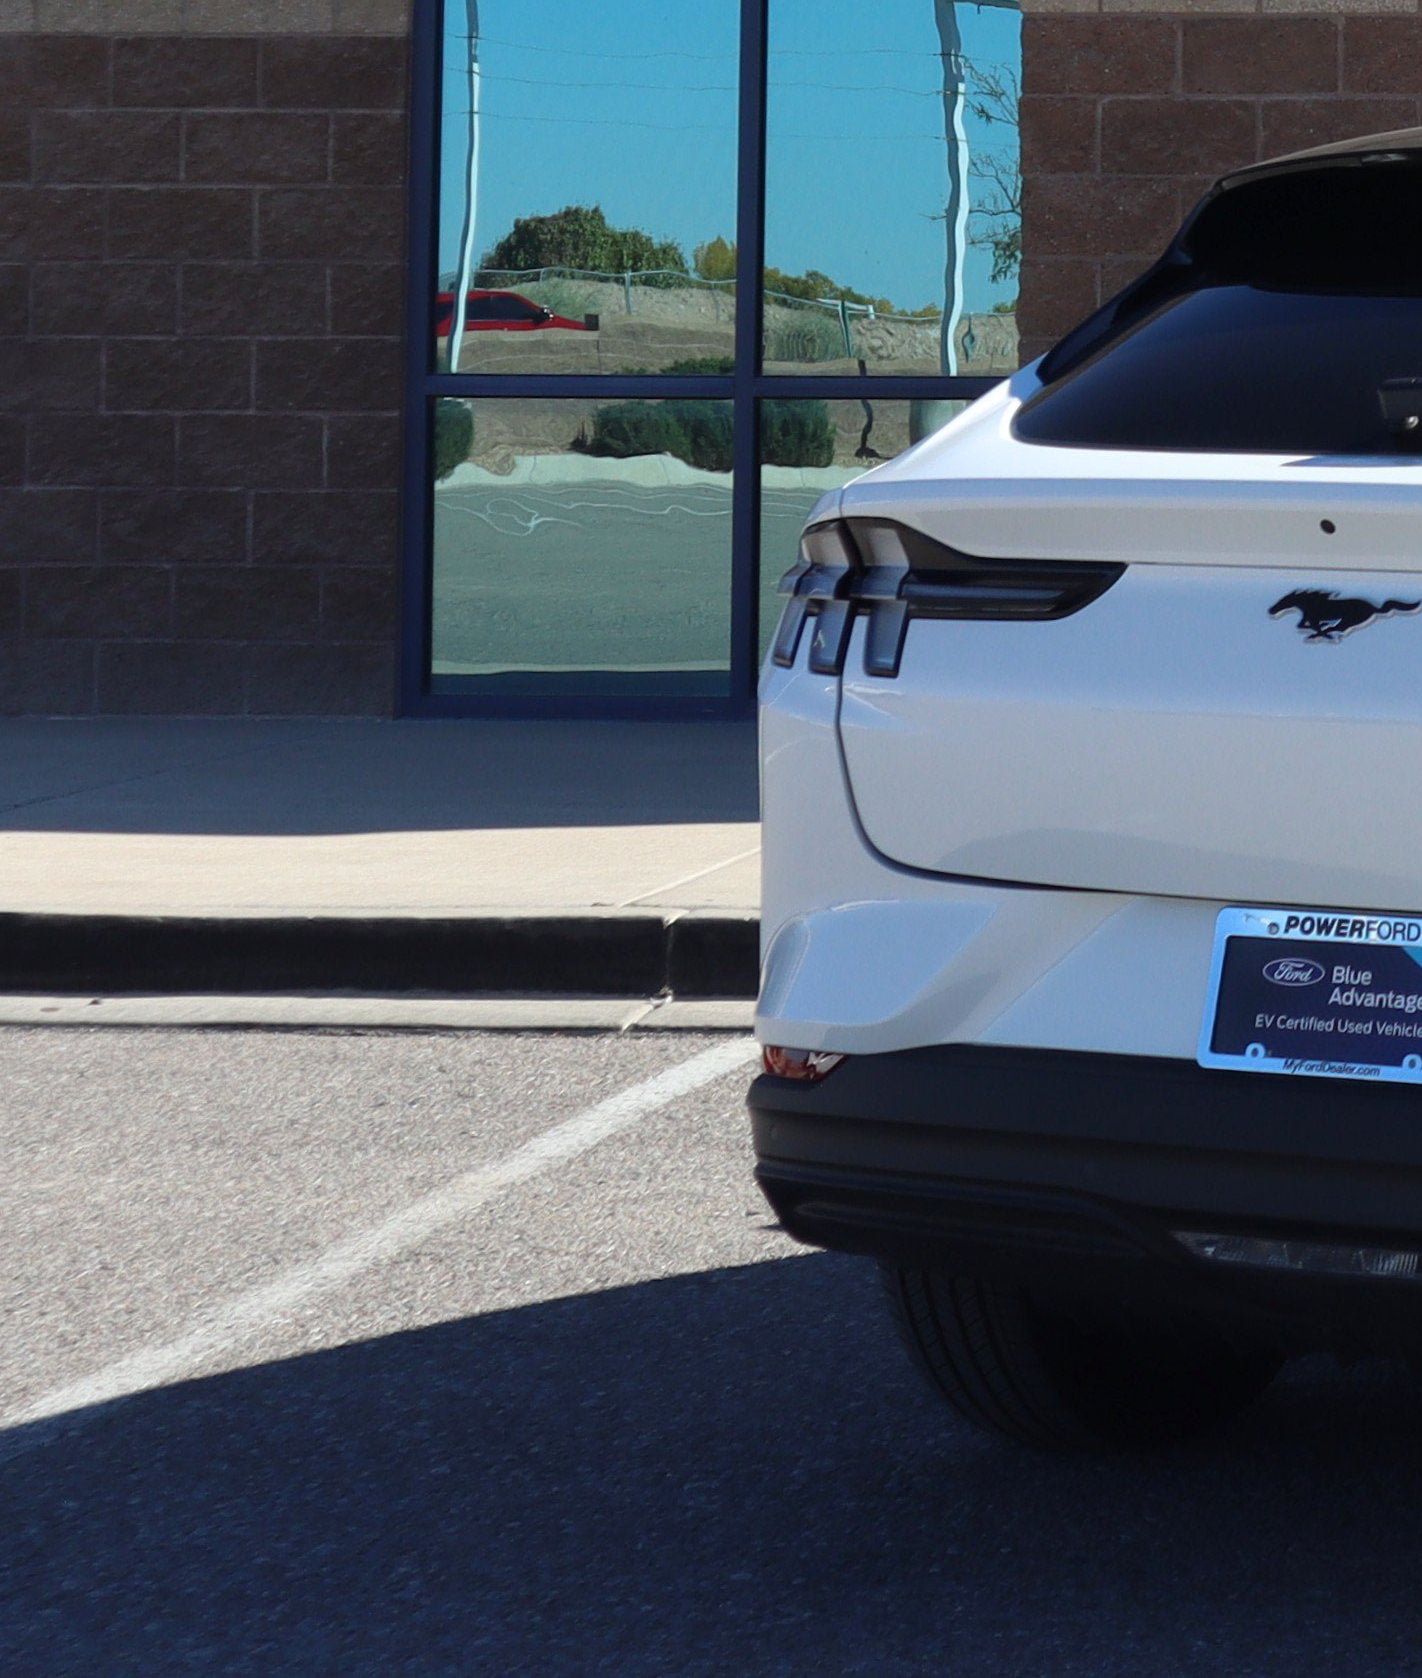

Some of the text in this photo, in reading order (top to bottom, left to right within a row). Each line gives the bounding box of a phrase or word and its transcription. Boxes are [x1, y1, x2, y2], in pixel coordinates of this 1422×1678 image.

[1283, 915, 1421, 942] POWERFORD
[1274, 961, 1313, 982] Ford
[1332, 966, 1372, 985] Blue
[1255, 1014, 1275, 1028] EV
[1276, 1015, 1334, 1032] Certified
[1338, 1019, 1372, 1035] Used
[1283, 1058, 1381, 1076] MyFordDealer.com
